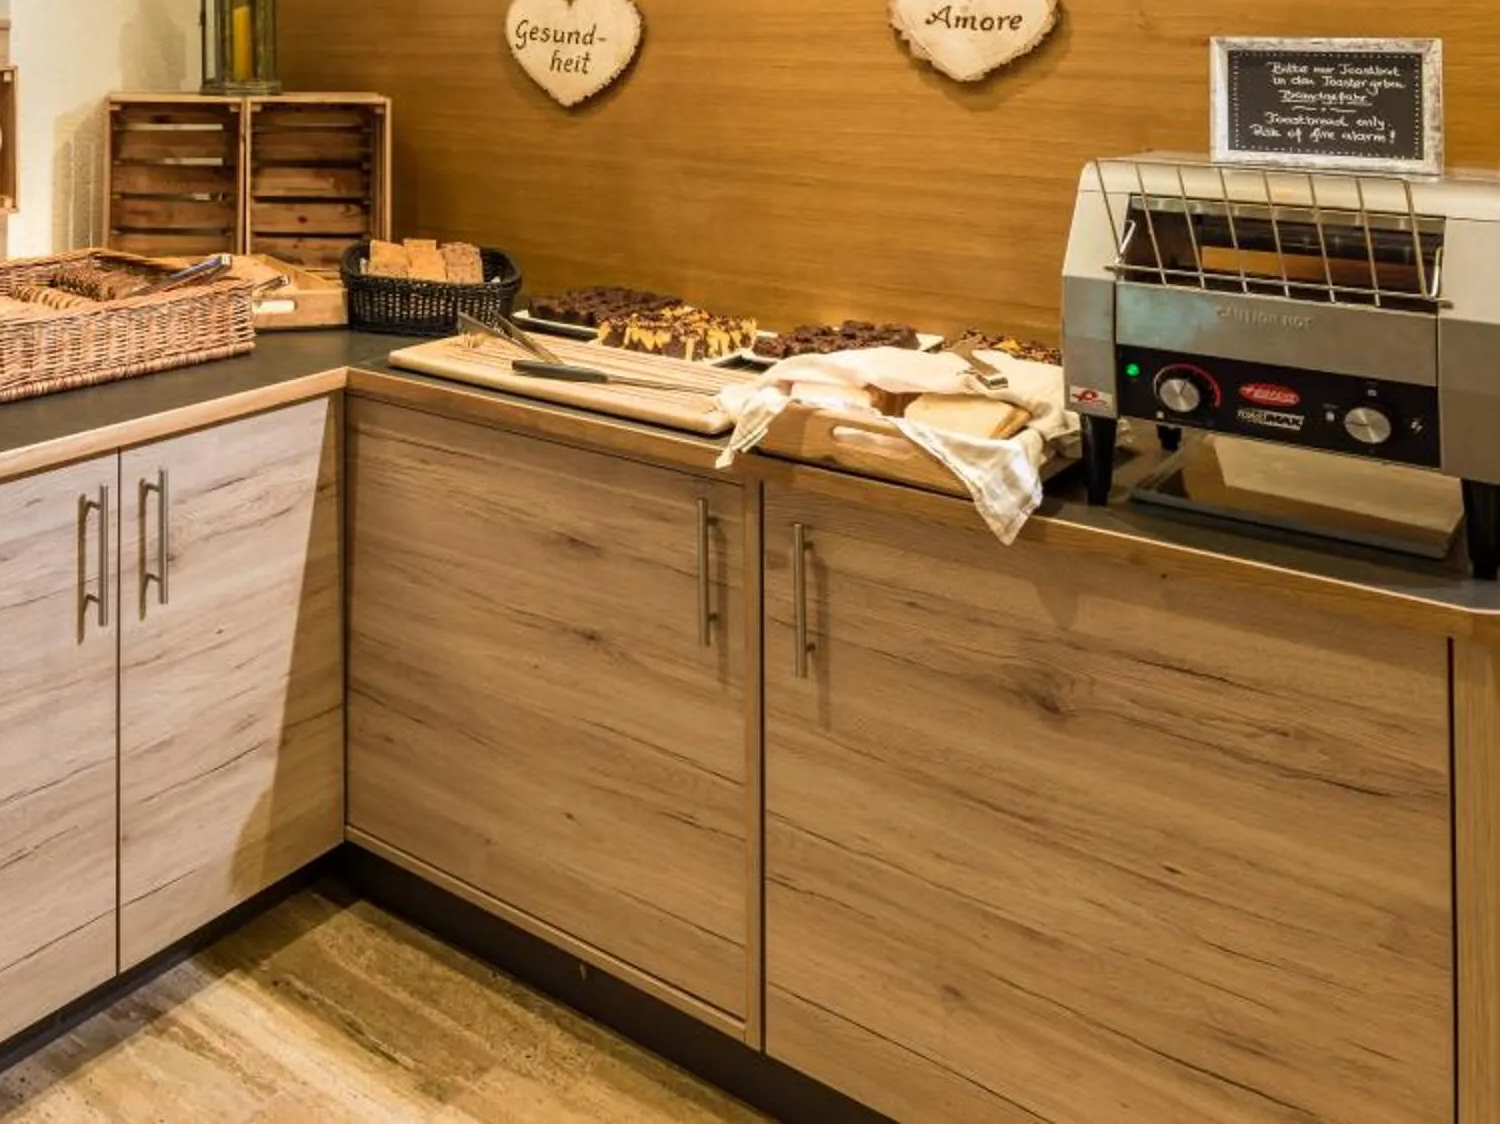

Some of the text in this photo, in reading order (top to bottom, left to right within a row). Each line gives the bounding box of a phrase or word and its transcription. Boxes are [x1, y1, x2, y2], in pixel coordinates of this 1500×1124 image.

[925, 5, 1023, 31] Amore
[515, 19, 607, 50] Gesund-
[550, 49, 592, 75] heit
[1266, 61, 1401, 77] Bitte nur Toastbrot
[1272, 75, 1287, 85] in
[1321, 75, 1367, 88] Toaster
[1264, 111, 1350, 126] Toastbread
[1287, 127, 1302, 143] of
[1309, 127, 1335, 143] fire
